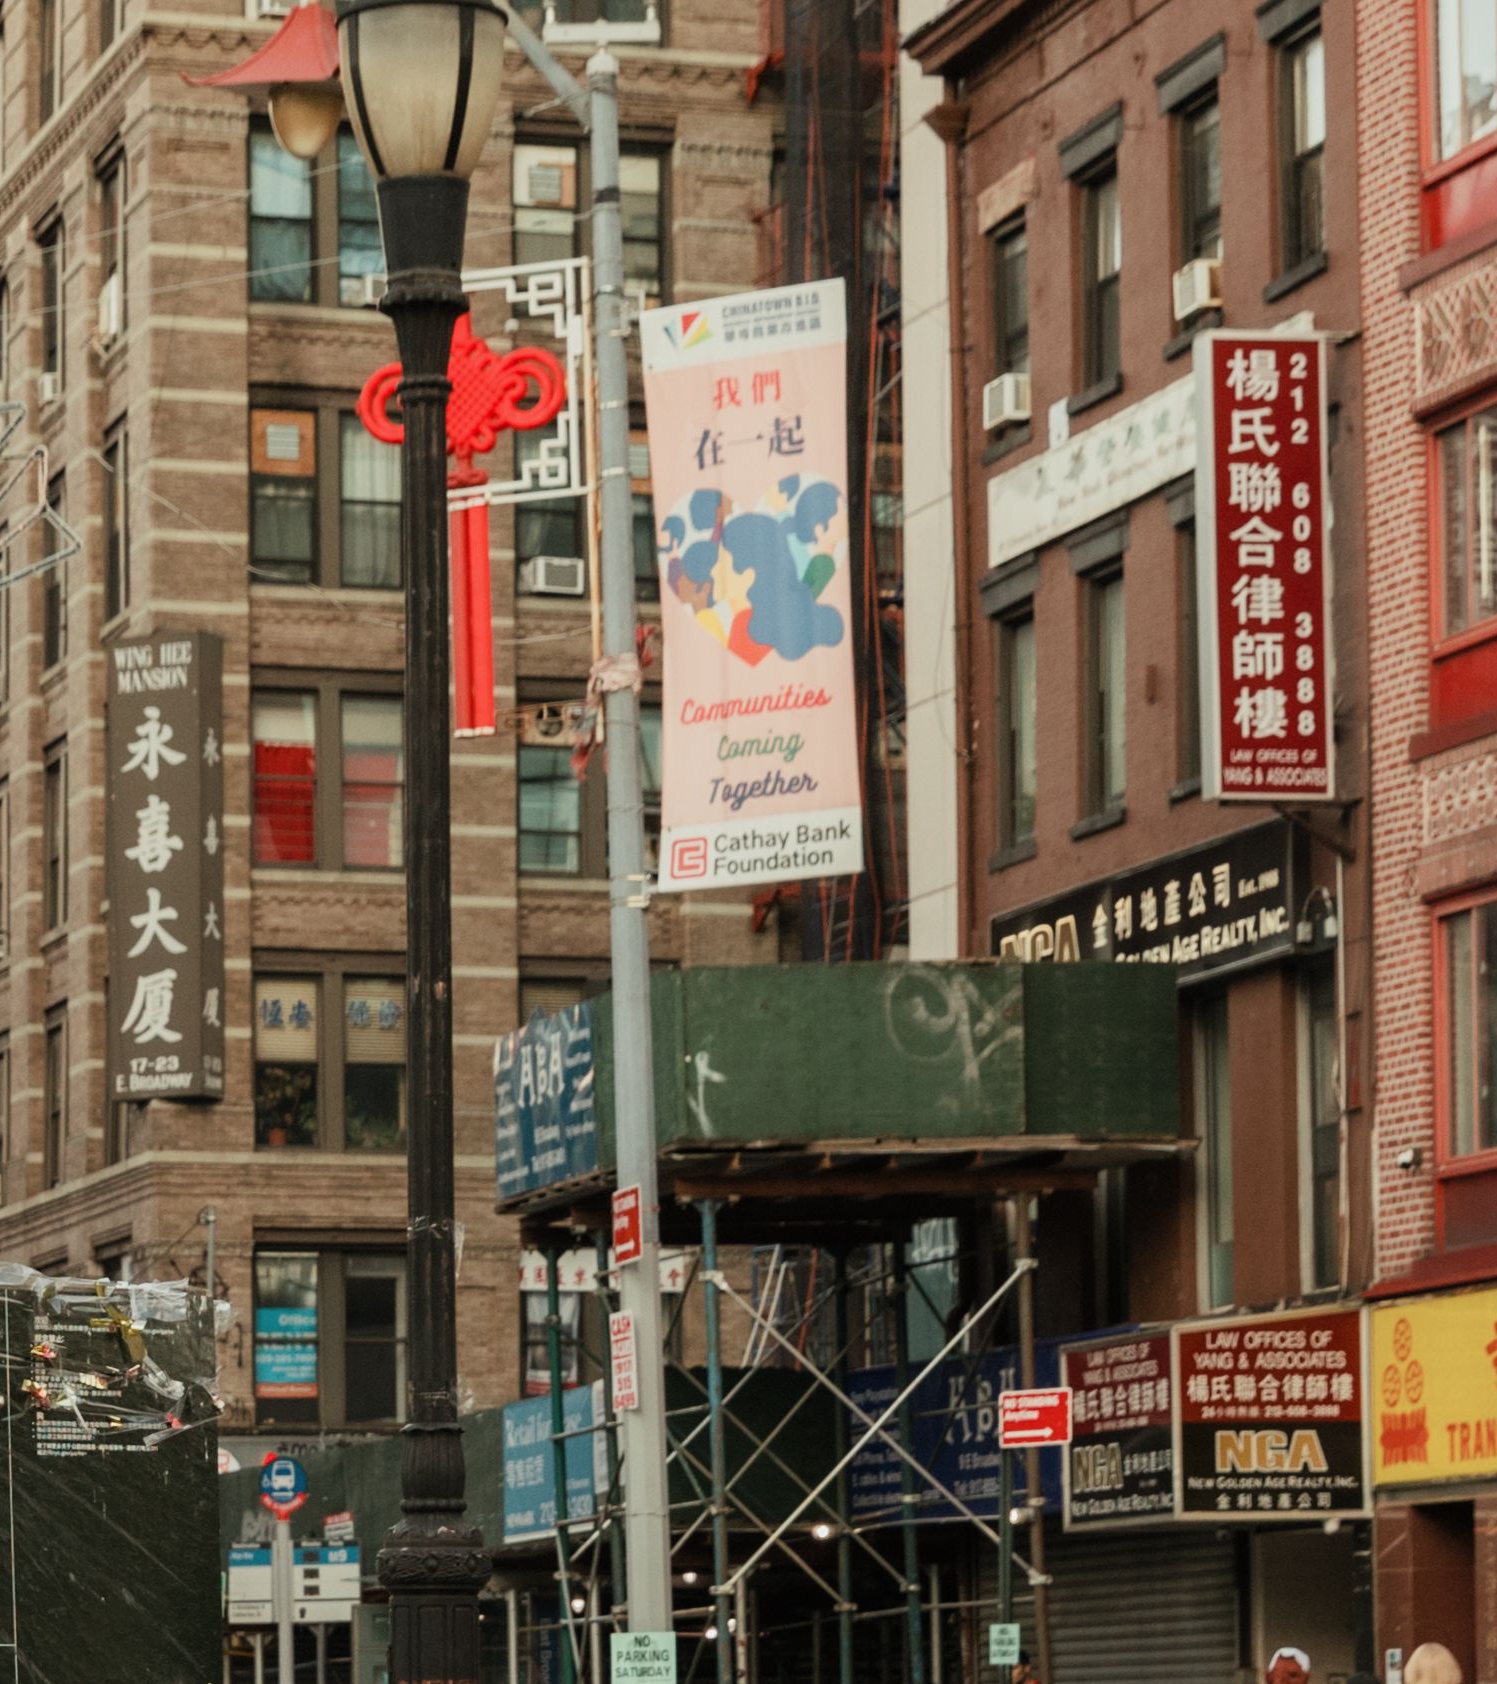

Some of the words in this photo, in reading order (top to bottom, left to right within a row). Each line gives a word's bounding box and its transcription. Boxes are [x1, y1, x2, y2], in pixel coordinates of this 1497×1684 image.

[722, 297, 792, 318] CHINATOWN
[713, 371, 781, 410] 我們
[693, 416, 806, 470] 在一起
[1226, 347, 1289, 740] 楊氏聯合律師樓
[114, 642, 154, 668] WING
[158, 641, 193, 666] HEE
[117, 665, 189, 695] MANSION
[680, 685, 833, 726] Communities
[716, 724, 805, 762] Coming
[1229, 748, 1254, 764] LAW
[1256, 747, 1298, 764] OFFICES
[1301, 748, 1319, 763] OF
[1222, 767, 1253, 786] YANG
[1266, 766, 1327, 786] ASSOCIATES
[708, 773, 818, 812] Together
[713, 826, 791, 858] Cathay
[796, 819, 852, 844] Bank
[713, 846, 835, 875] Foundation
[1092, 862, 1231, 949] 金利地產公司
[129, 1056, 181, 1073] 17-23
[116, 1075, 127, 1093] E.
[129, 1072, 193, 1094] BROADWAY
[1206, 1332, 1240, 1350] LAW
[1243, 1331, 1307, 1350] OFFICES
[1309, 1330, 1334, 1349] OF
[1193, 1352, 1235, 1370] YANG
[1237, 1352, 1249, 1370] &
[1254, 1350, 1348, 1370] ASSOCIATES
[1186, 1373, 1354, 1402] 楊氏聯合律師樓
[1214, 1429, 1329, 1473] NGA
[1073, 1441, 1124, 1493] NGA
[1216, 1476, 1263, 1490] GOLDEN
[1263, 1476, 1288, 1490] AGE
[1215, 1492, 1333, 1510] 金利地產公司
[616, 1648, 671, 1662] PARKING
[633, 1635, 651, 1647] NO
[614, 1666, 672, 1678] SATURDAY
